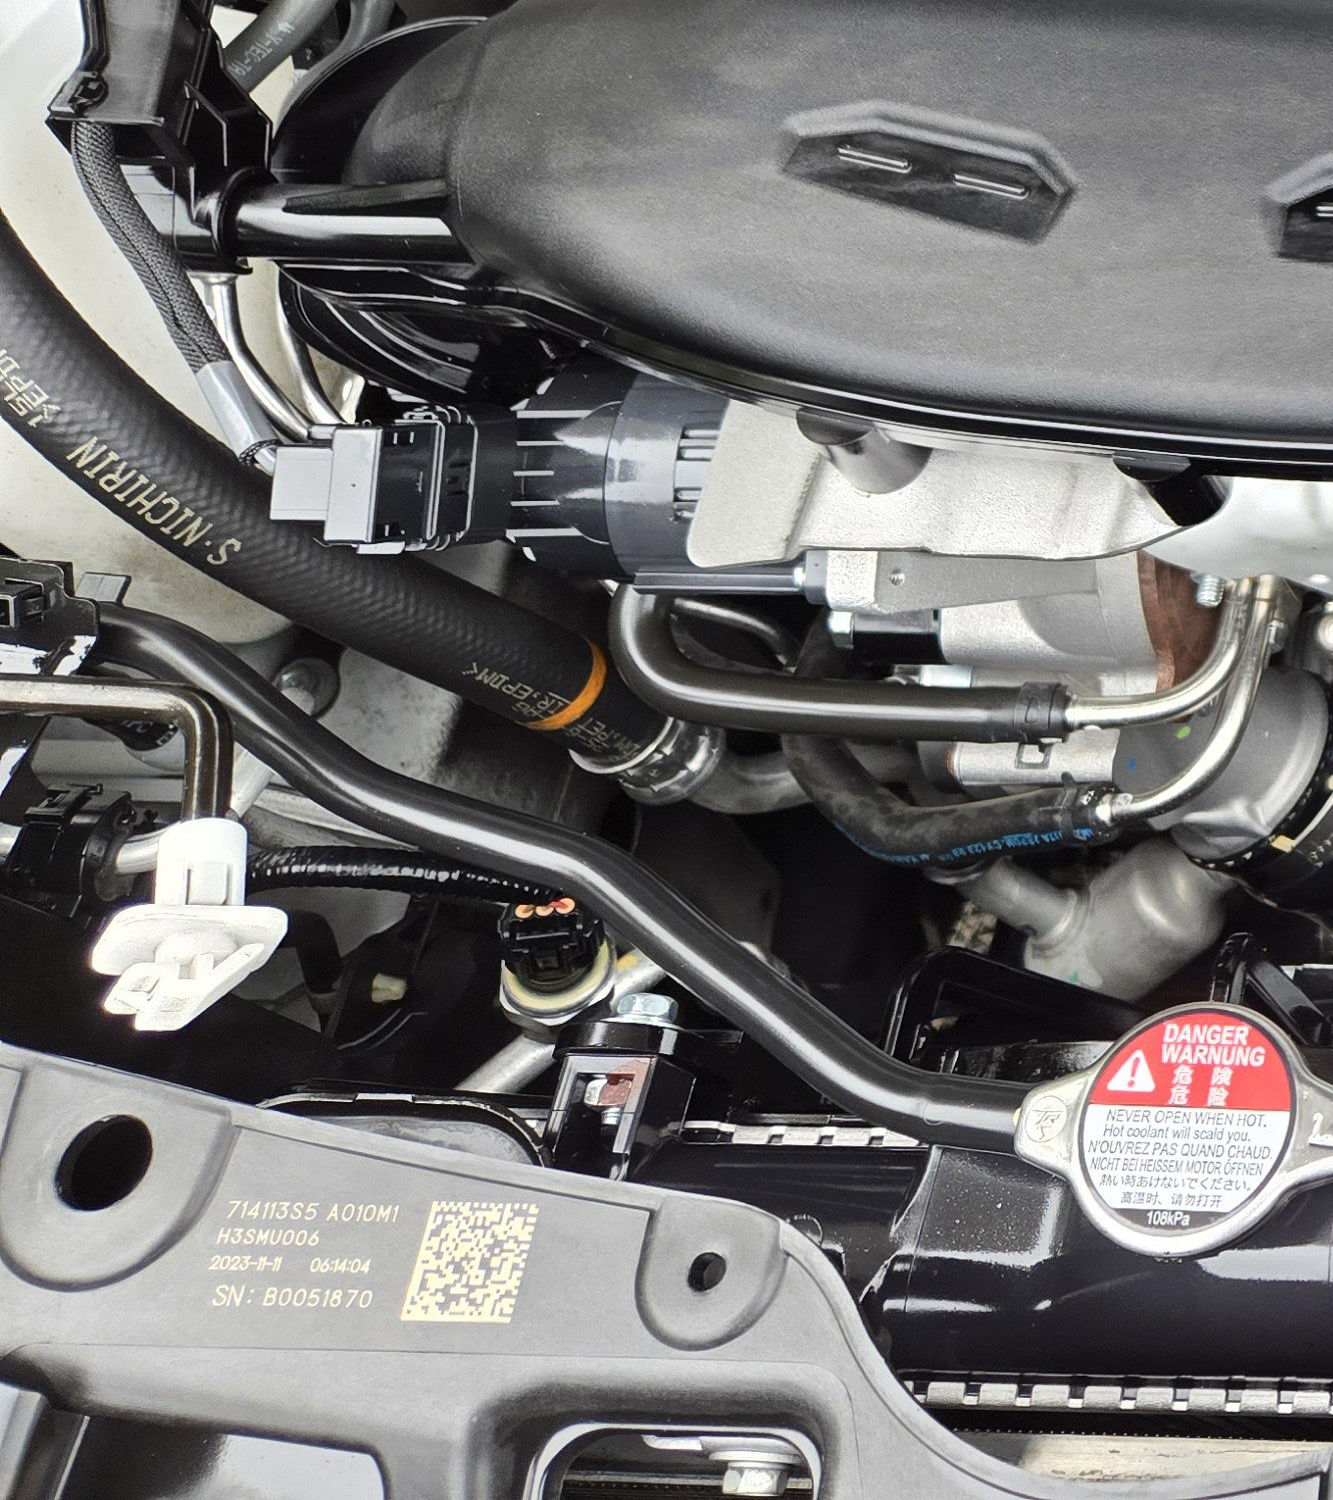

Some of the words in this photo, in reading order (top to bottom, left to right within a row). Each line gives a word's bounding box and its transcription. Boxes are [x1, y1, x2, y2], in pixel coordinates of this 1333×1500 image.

[1163, 1023, 1250, 1045] DANGER
[1160, 1044, 1266, 1067] WARNUNG
[1107, 1109, 1151, 1124] NEVER
[1155, 1111, 1192, 1125] OPEN
[1194, 1112, 1232, 1126] WHEN
[1236, 1113, 1268, 1128] HOT.
[1103, 1127, 1125, 1137] Hot
[1126, 1127, 1169, 1138] coolant
[1172, 1128, 1190, 1139] will
[1193, 1128, 1223, 1139] scald
[1226, 1131, 1251, 1142] you.
[1088, 1141, 1150, 1154] N'OUVREZ
[1152, 1142, 1178, 1155] PAS
[1181, 1143, 1225, 1158] QUAND
[1227, 1145, 1273, 1159] CHAUD.
[1090, 1158, 1119, 1171] NICHT
[1122, 1159, 1138, 1172] BEI
[1139, 1159, 1182, 1173] HEISSEM
[1186, 1160, 1221, 1174] MOTOR
[227, 1201, 317, 1221] 714113S5
[326, 1203, 399, 1223] A010M1
[1146, 1210, 1190, 1227] 108kPa
[216, 1231, 320, 1247] H3SMU006
[208, 1255, 282, 1273] 2023-11-11
[310, 1258, 371, 1275] 06:14:04
[212, 1285, 253, 1308] SN:
[262, 1287, 373, 1309] B0051870
